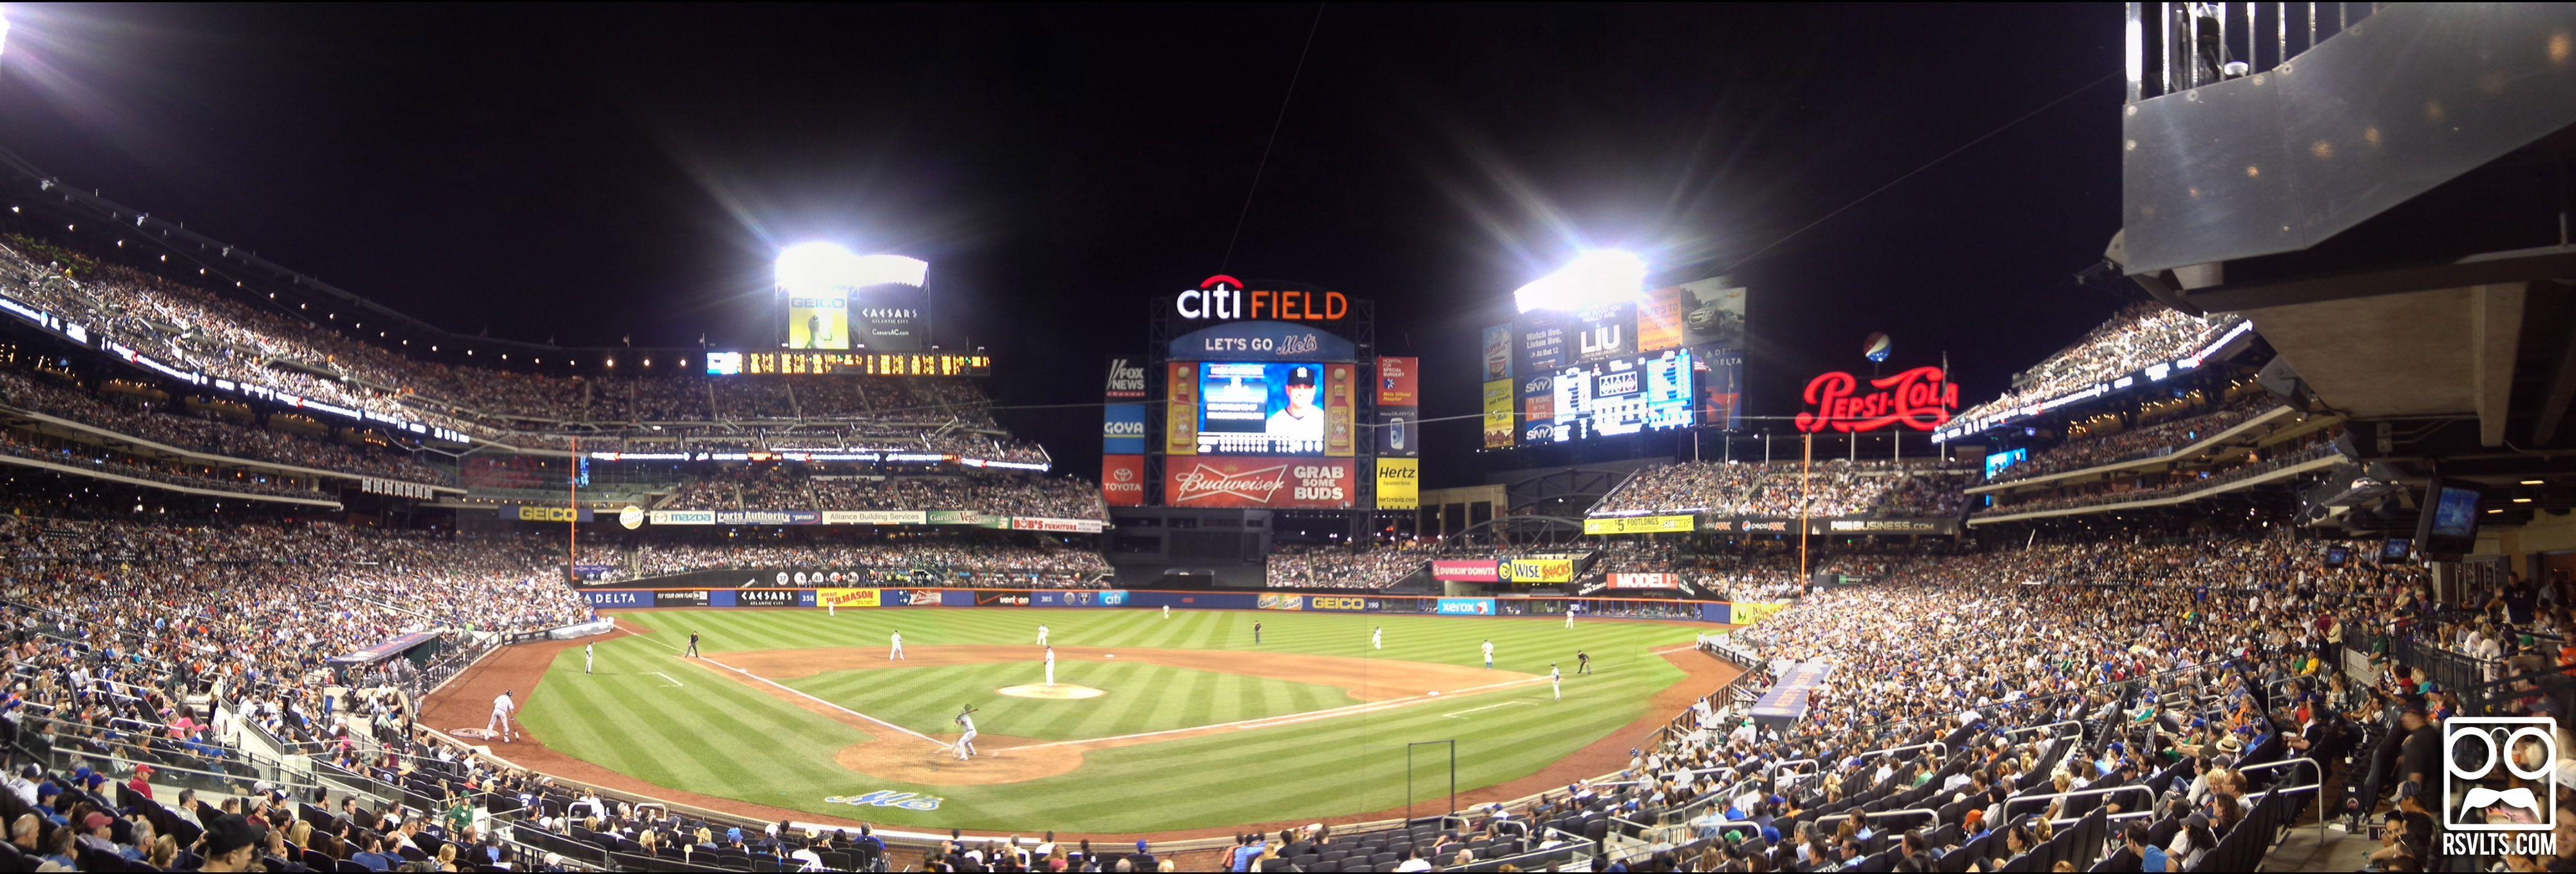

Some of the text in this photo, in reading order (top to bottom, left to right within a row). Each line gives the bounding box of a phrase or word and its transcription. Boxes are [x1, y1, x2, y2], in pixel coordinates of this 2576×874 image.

[791, 298, 845, 308] GEICO
[1251, 290, 1348, 319] FIELD
[862, 309, 918, 318] CAESARS
[1526, 328, 1562, 341] Watch live.
[1580, 324, 1620, 354] LIU
[1205, 333, 1318, 355] LET'S GO Mets
[1526, 337, 1562, 348] Listen live.
[1714, 357, 1743, 366] DELTA
[1119, 368, 1144, 379] FOX
[1112, 379, 1145, 390] NEWS
[1525, 380, 1548, 393] SNY
[1533, 411, 1547, 419] METS
[1104, 421, 1144, 434] GOYA
[1526, 428, 1549, 441] SNY
[1294, 466, 1345, 479] GRAB
[1379, 467, 1416, 479] Hertz
[1105, 482, 1141, 491] TOYOTA
[1175, 472, 1285, 493] Budweiser
[1302, 479, 1336, 487] SOME
[1294, 486, 1344, 500] BUDS
[519, 506, 578, 522] GEICO
[670, 512, 711, 522] mazda
[717, 511, 744, 523] Parts
[744, 511, 791, 523] Authority
[860, 513, 888, 521] Building
[1627, 517, 1659, 526] FOOTLONGS
[1440, 566, 1495, 576] DUNKIN' DONUTS
[1542, 561, 1571, 580] SNACKS
[595, 593, 636, 603] DELTA
[741, 591, 792, 600] CAESARS
[999, 595, 1030, 606] verizon
[1104, 594, 1122, 605] citi
[1259, 596, 1278, 607] Gulf
[1283, 597, 1302, 609] Gulf
[1312, 597, 1365, 610] GEICO
[1442, 602, 1474, 613] xerox
